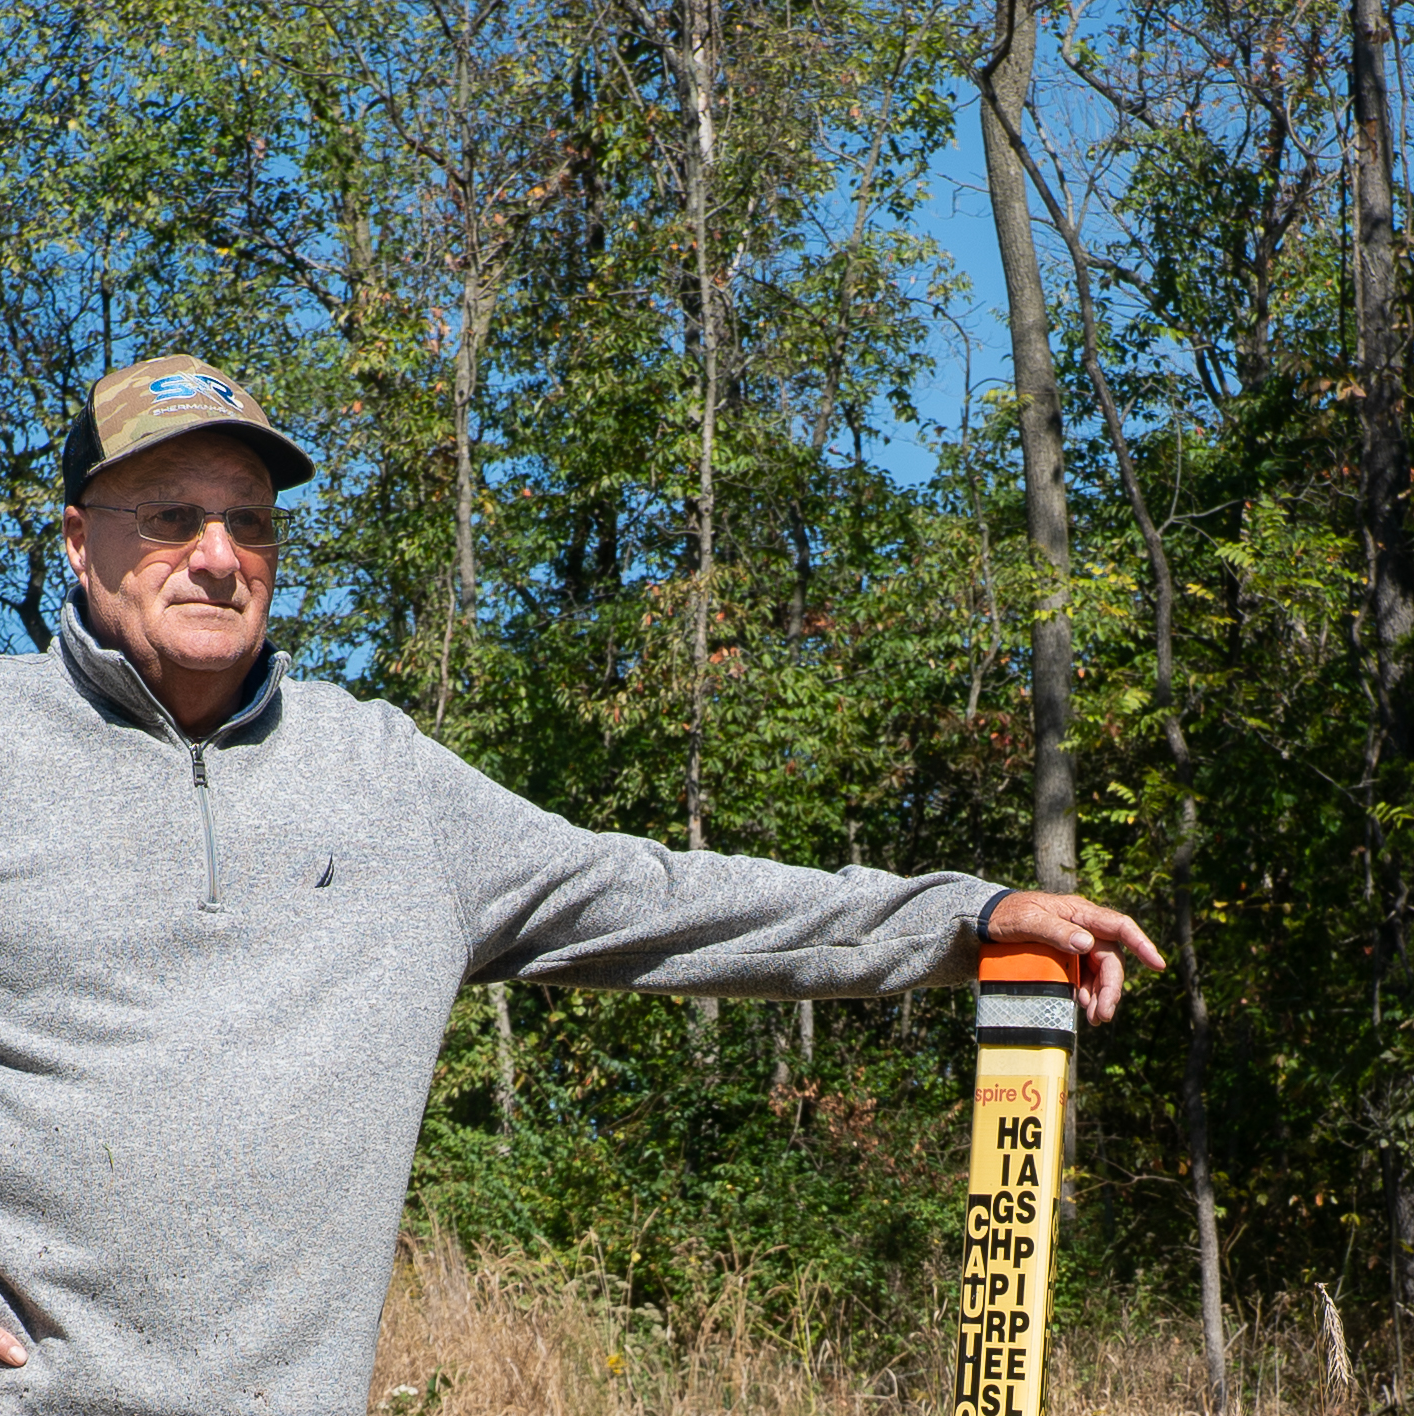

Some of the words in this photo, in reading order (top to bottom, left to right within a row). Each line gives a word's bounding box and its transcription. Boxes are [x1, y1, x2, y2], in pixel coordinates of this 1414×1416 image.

[975, 1083, 1017, 1107] spire
[990, 1116, 1020, 1261] HIGH
[1016, 1116, 1042, 1225] GAS
